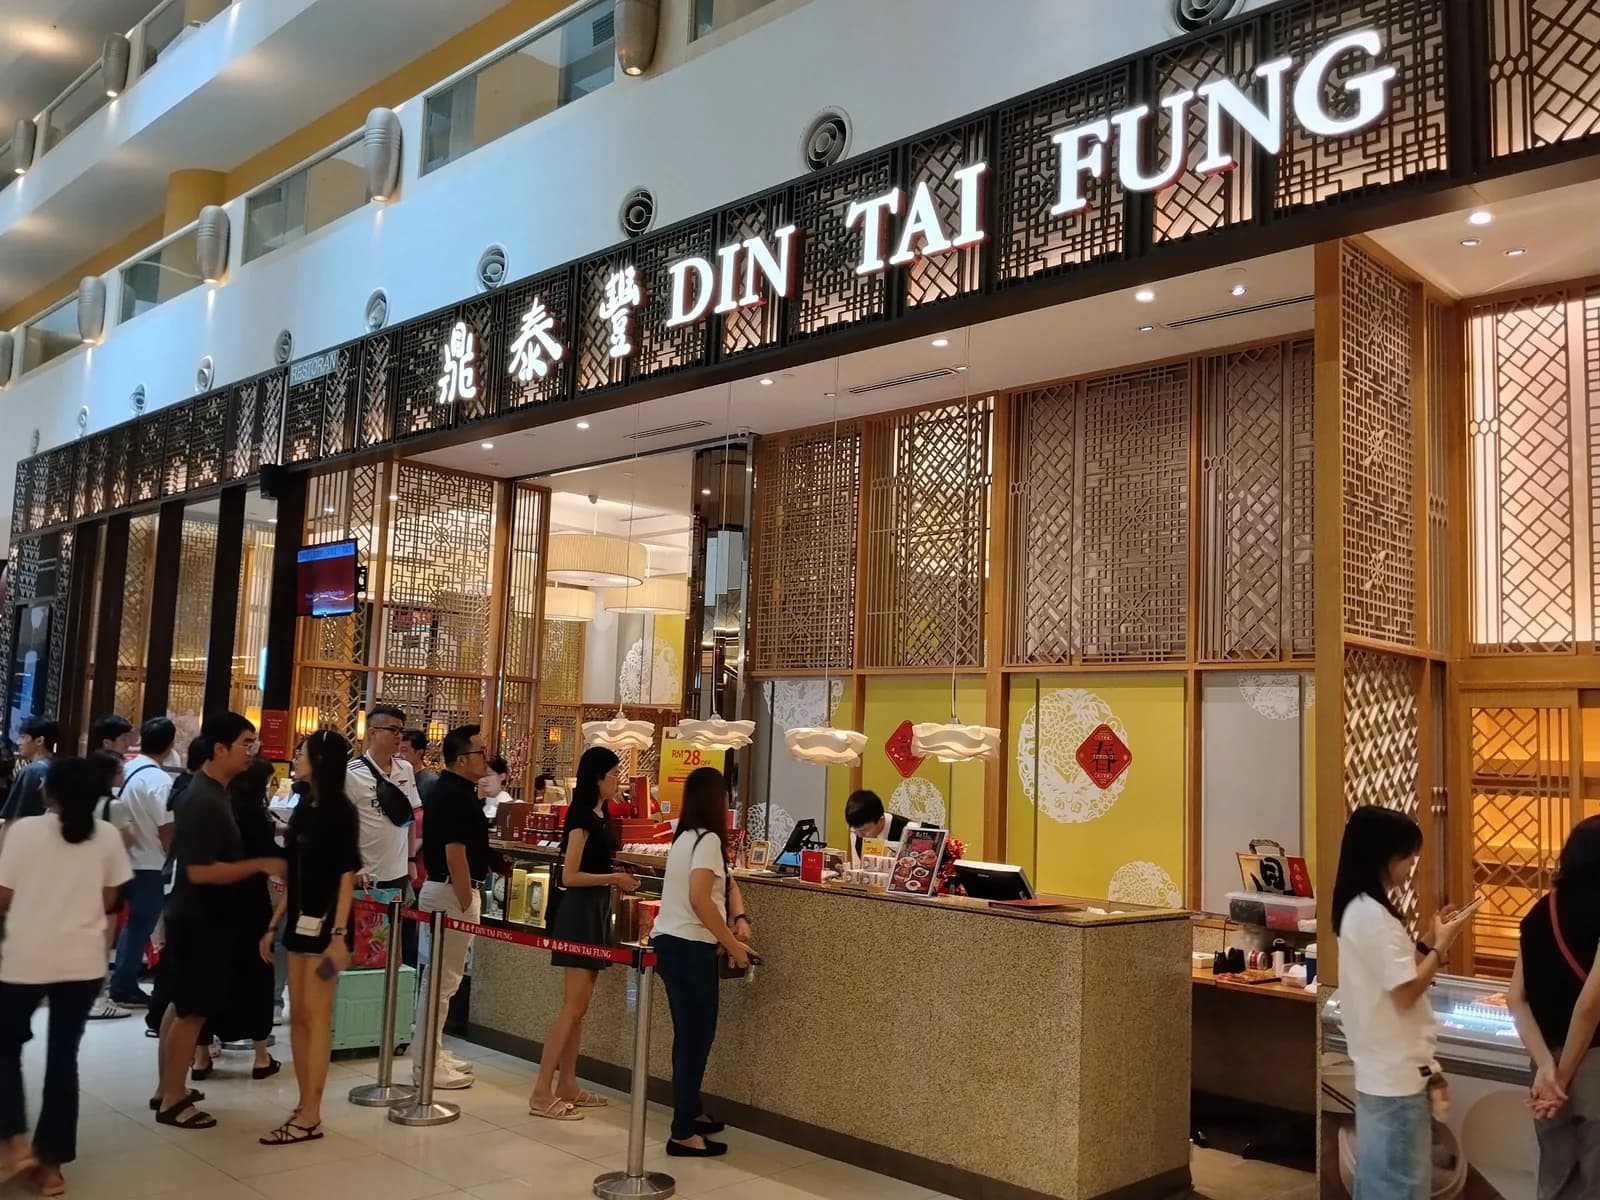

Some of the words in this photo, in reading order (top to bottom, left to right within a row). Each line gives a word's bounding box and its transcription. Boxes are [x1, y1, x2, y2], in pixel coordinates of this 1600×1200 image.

[666, 225, 796, 328] DIN
[846, 162, 987, 275] TAI
[1050, 29, 1397, 216] FUNG
[291, 352, 338, 381] RESTORAN
[496, 930, 513, 940] FUNG
[568, 944, 580, 953] DIN
[581, 946, 592, 956] TAI
[592, 948, 611, 958] FUNG
